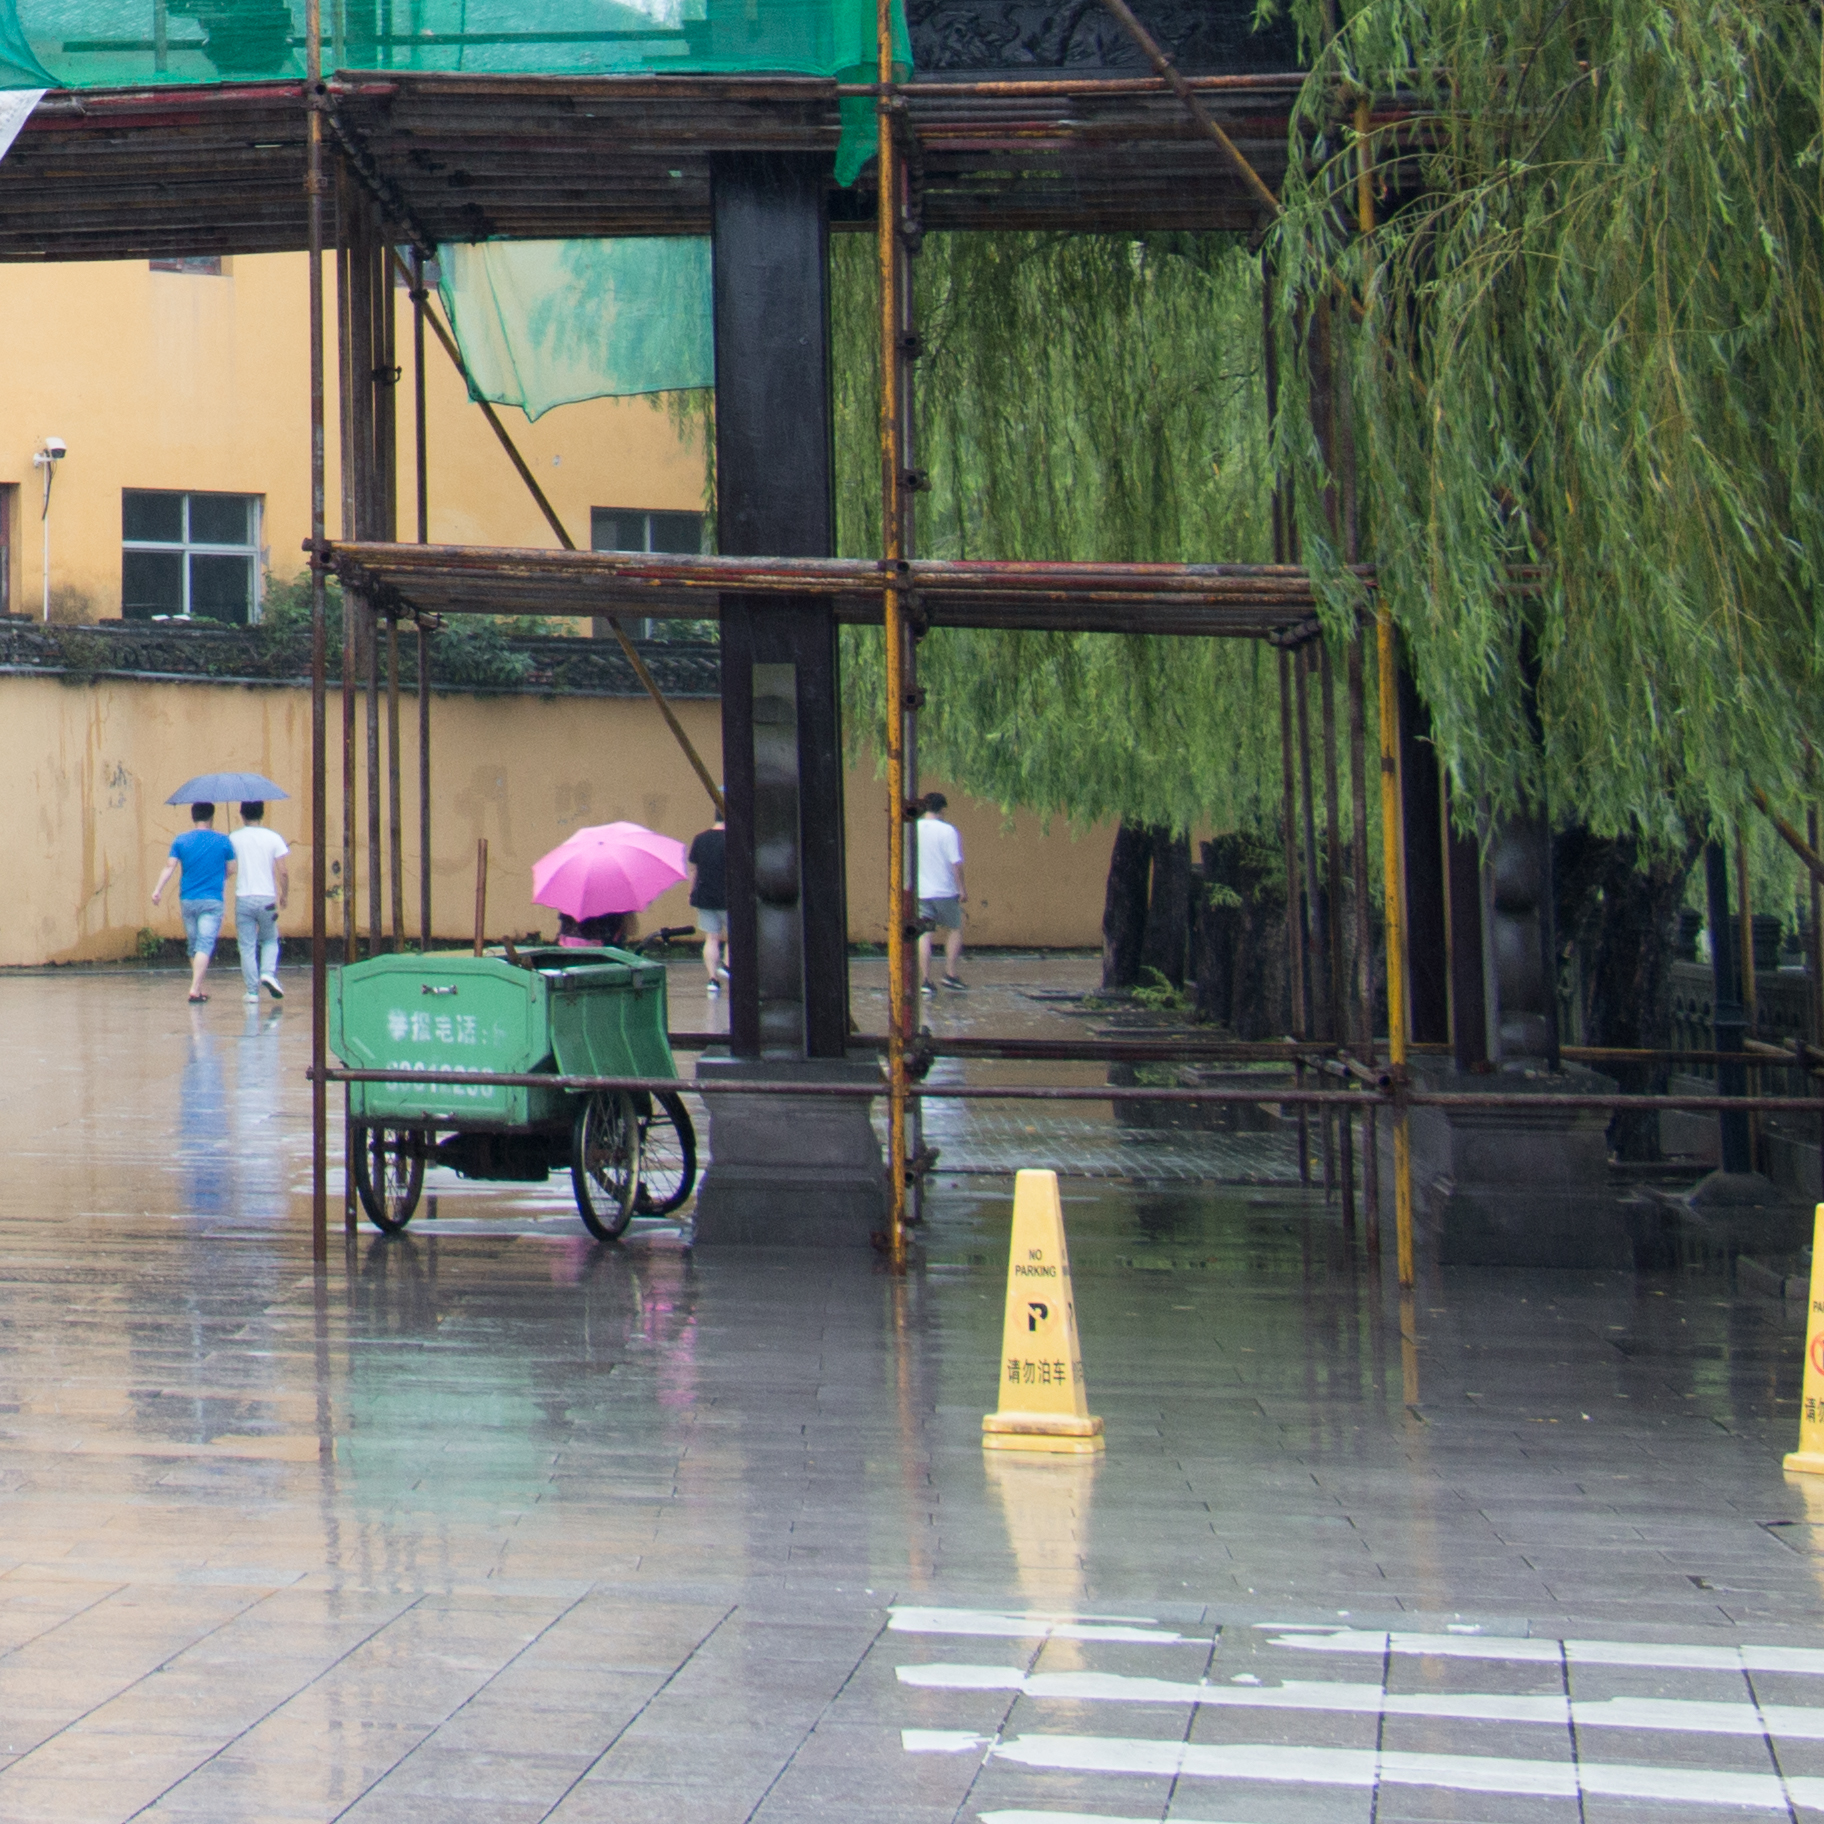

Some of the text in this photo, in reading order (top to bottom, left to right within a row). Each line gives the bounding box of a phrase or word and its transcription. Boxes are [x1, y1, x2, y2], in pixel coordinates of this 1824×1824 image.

[1029, 1249, 1042, 1261] NO
[1015, 1265, 1056, 1277] PARKING
[1007, 1358, 1066, 1386] 请勿泊车
